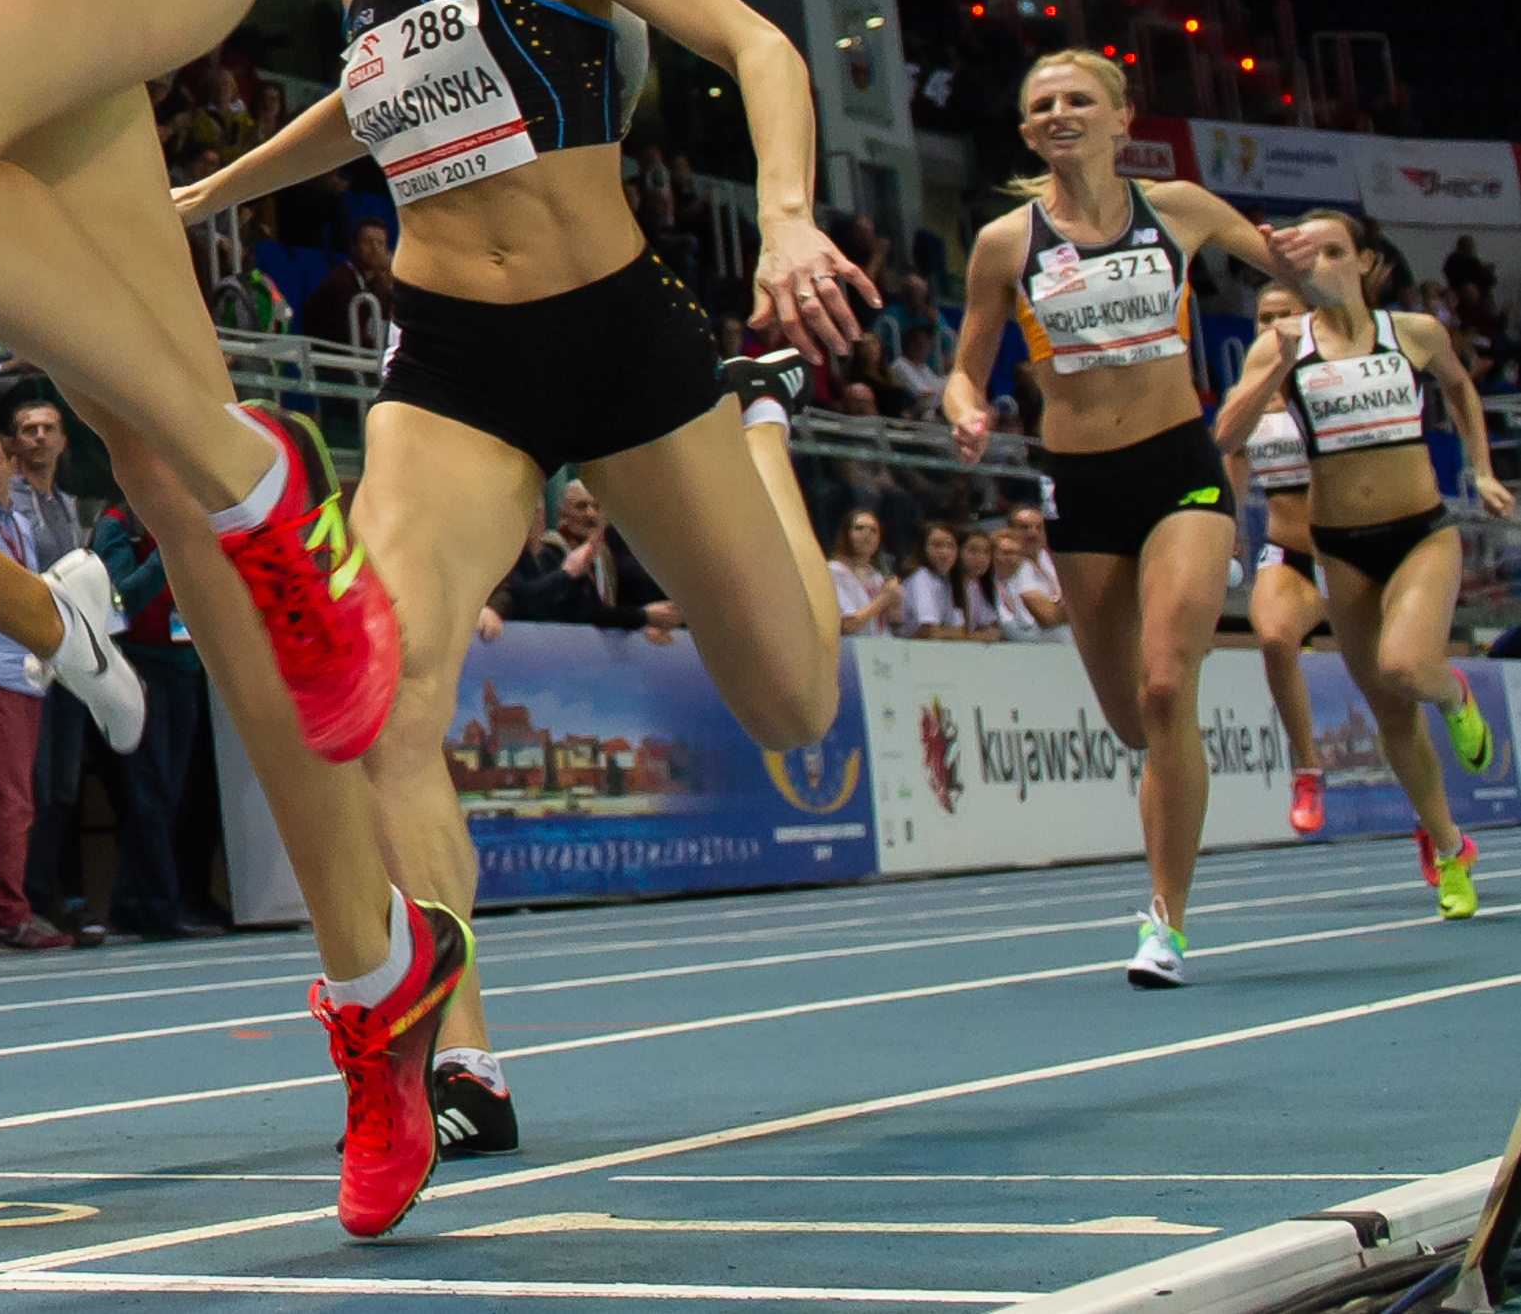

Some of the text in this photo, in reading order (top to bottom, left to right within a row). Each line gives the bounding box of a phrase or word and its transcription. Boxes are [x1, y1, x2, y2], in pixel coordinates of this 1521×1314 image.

[400, 4, 466, 60] 288
[440, 153, 487, 184] 2019
[1104, 253, 1163, 282] 371
[1358, 355, 1402, 378] 119
[1310, 385, 1413, 421] SAGANIAK
